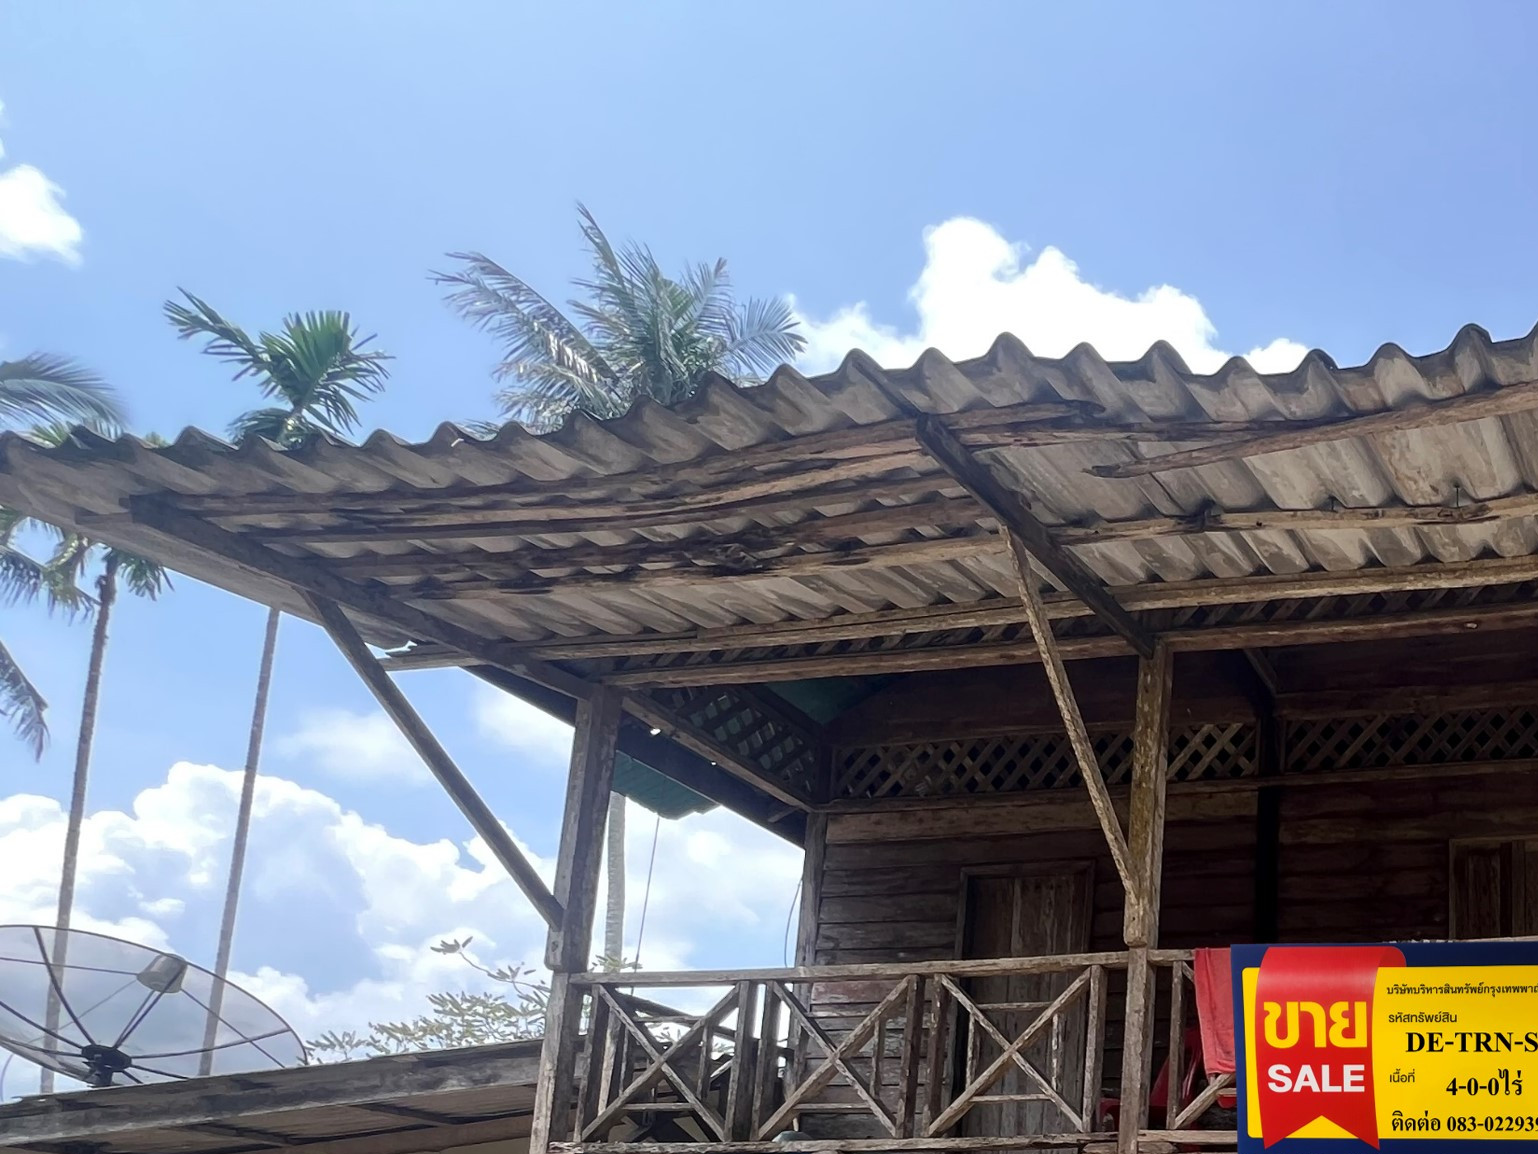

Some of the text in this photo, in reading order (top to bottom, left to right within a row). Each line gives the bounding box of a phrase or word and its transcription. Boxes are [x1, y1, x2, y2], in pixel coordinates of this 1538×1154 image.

[1264, 1000, 1367, 1049] ขาย
[1389, 1011, 1457, 1024] รหัสทรัพย์สิน
[1267, 1064, 1365, 1093] SALE
[1389, 1069, 1415, 1085] เนื้อที่
[1392, 1110, 1441, 1133] ติดต่อ
